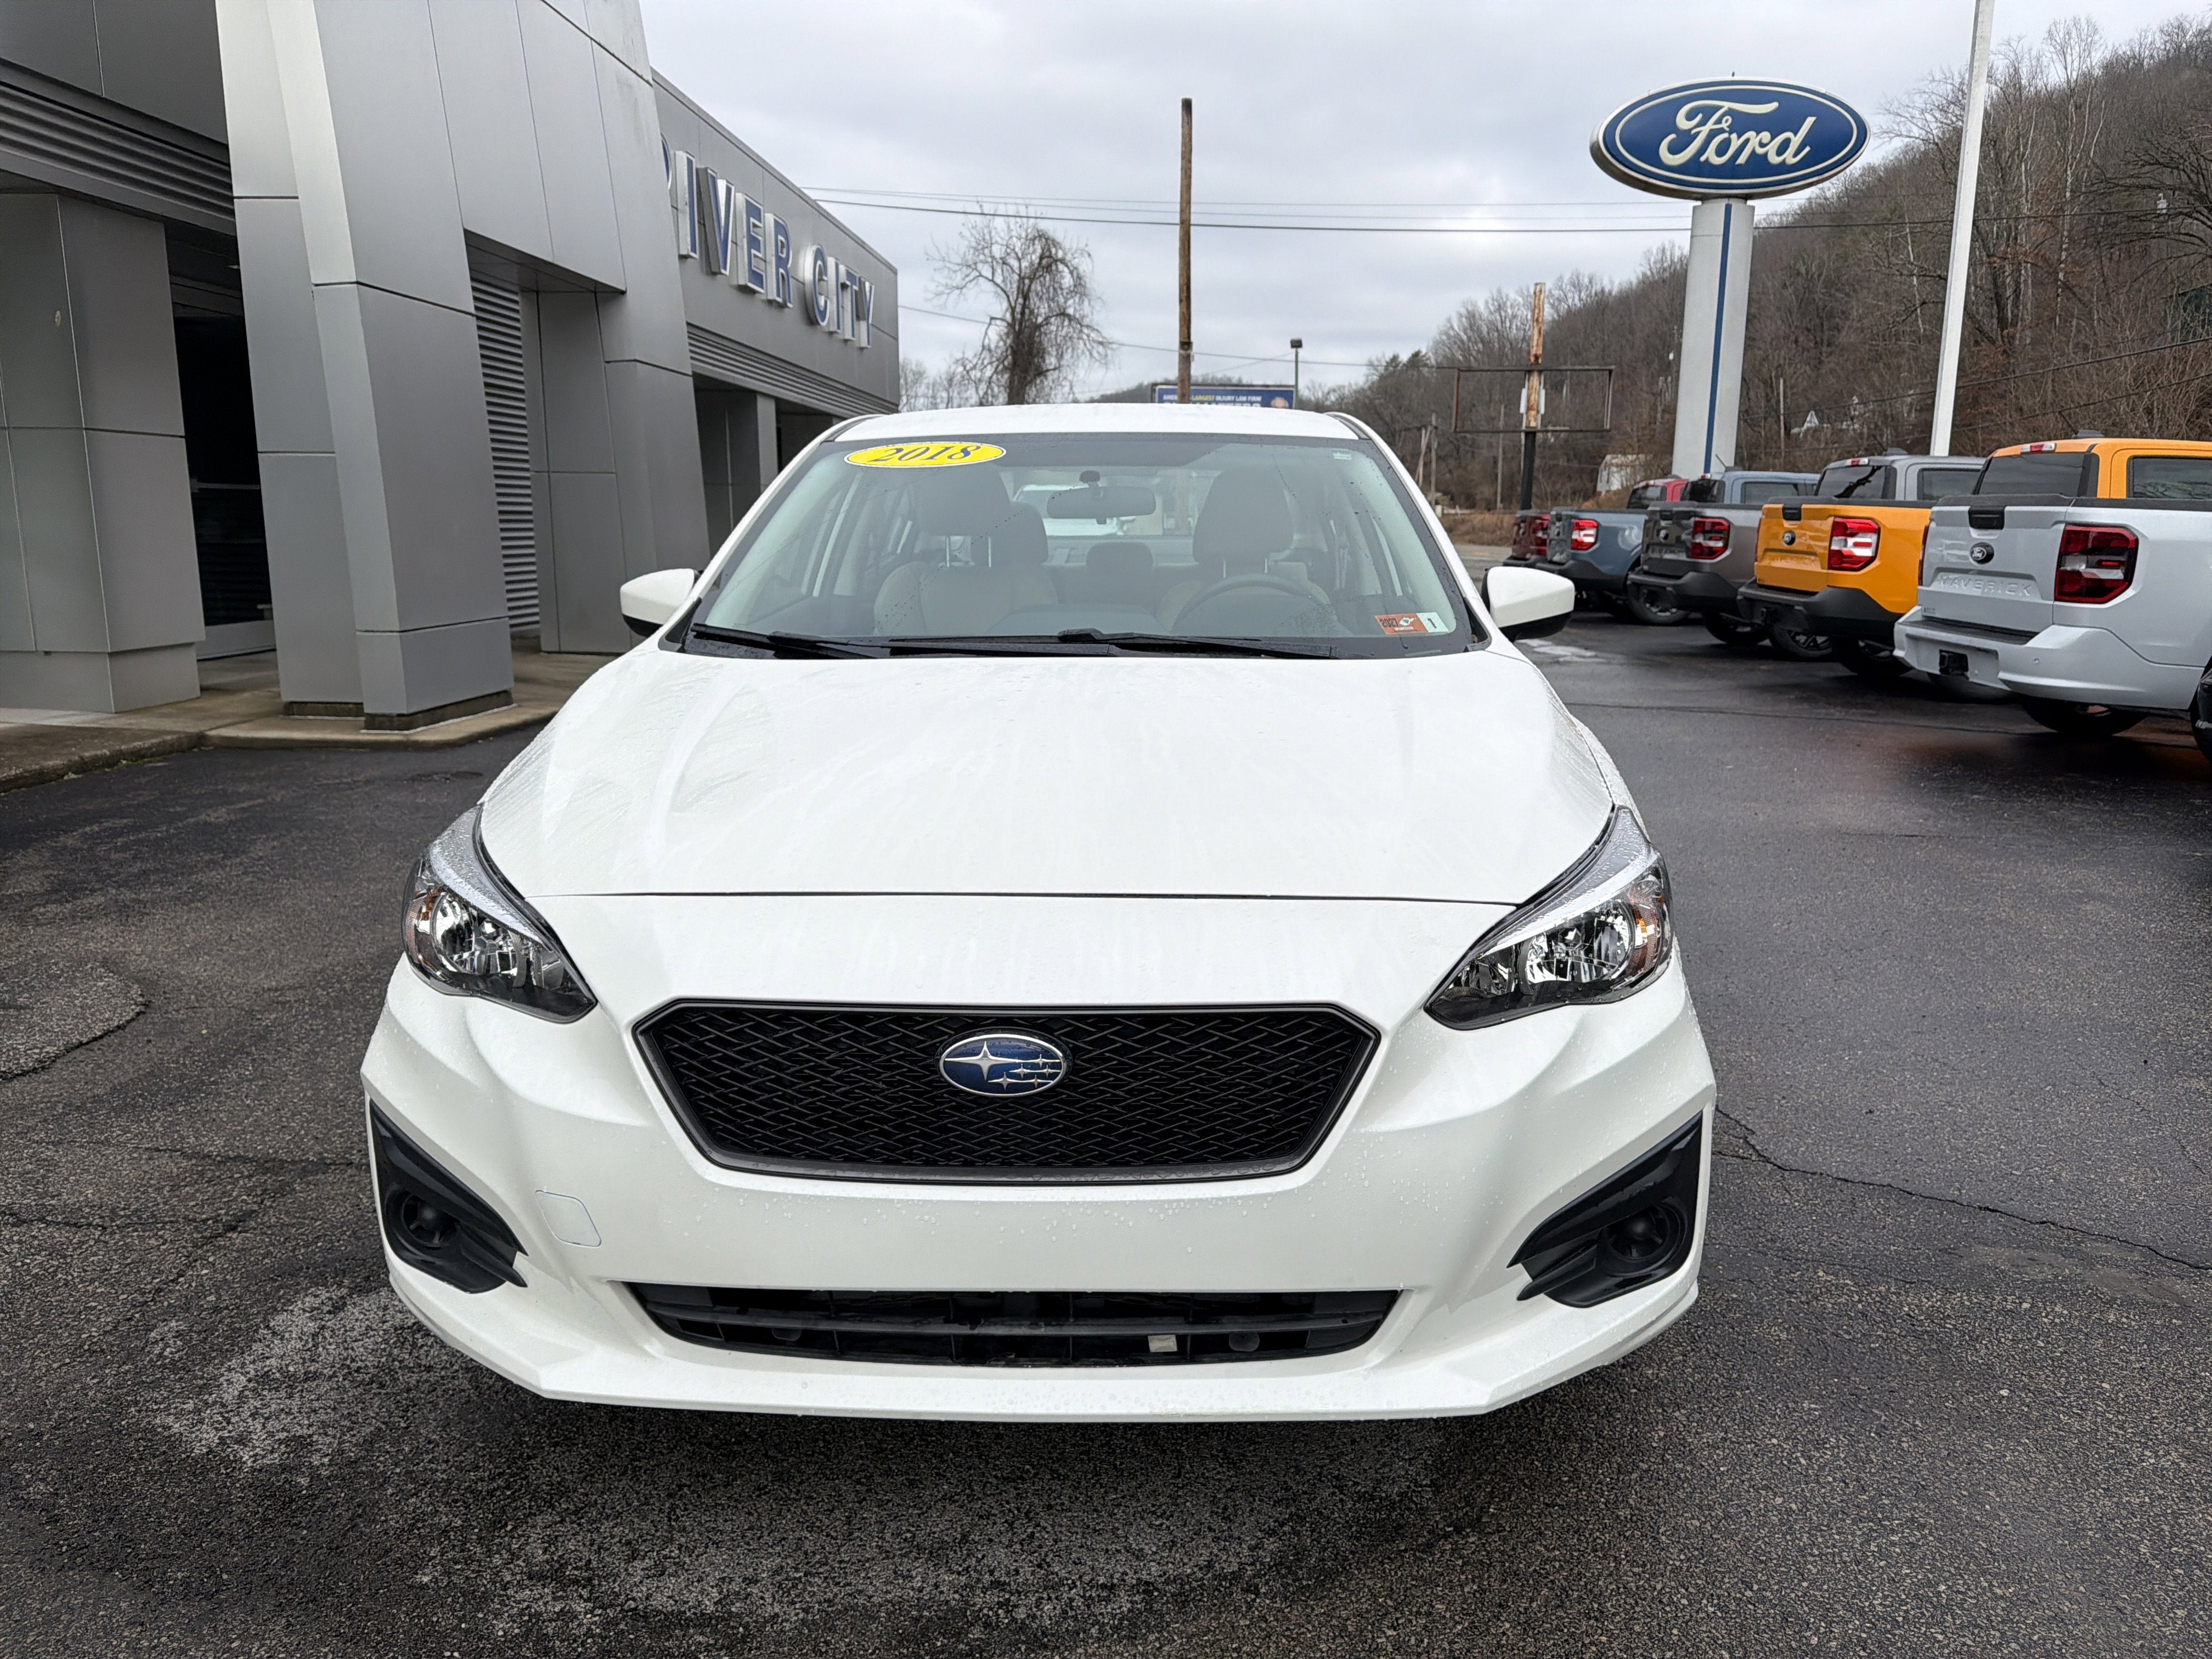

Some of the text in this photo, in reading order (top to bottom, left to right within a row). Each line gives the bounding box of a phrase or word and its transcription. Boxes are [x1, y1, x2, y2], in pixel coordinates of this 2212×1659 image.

[1658, 99, 1817, 166] Ford
[804, 244, 874, 348] CITY
[867, 445, 981, 462] 2018
[1939, 575, 2032, 597] MAVERICK
[1427, 618, 1437, 629] 1
